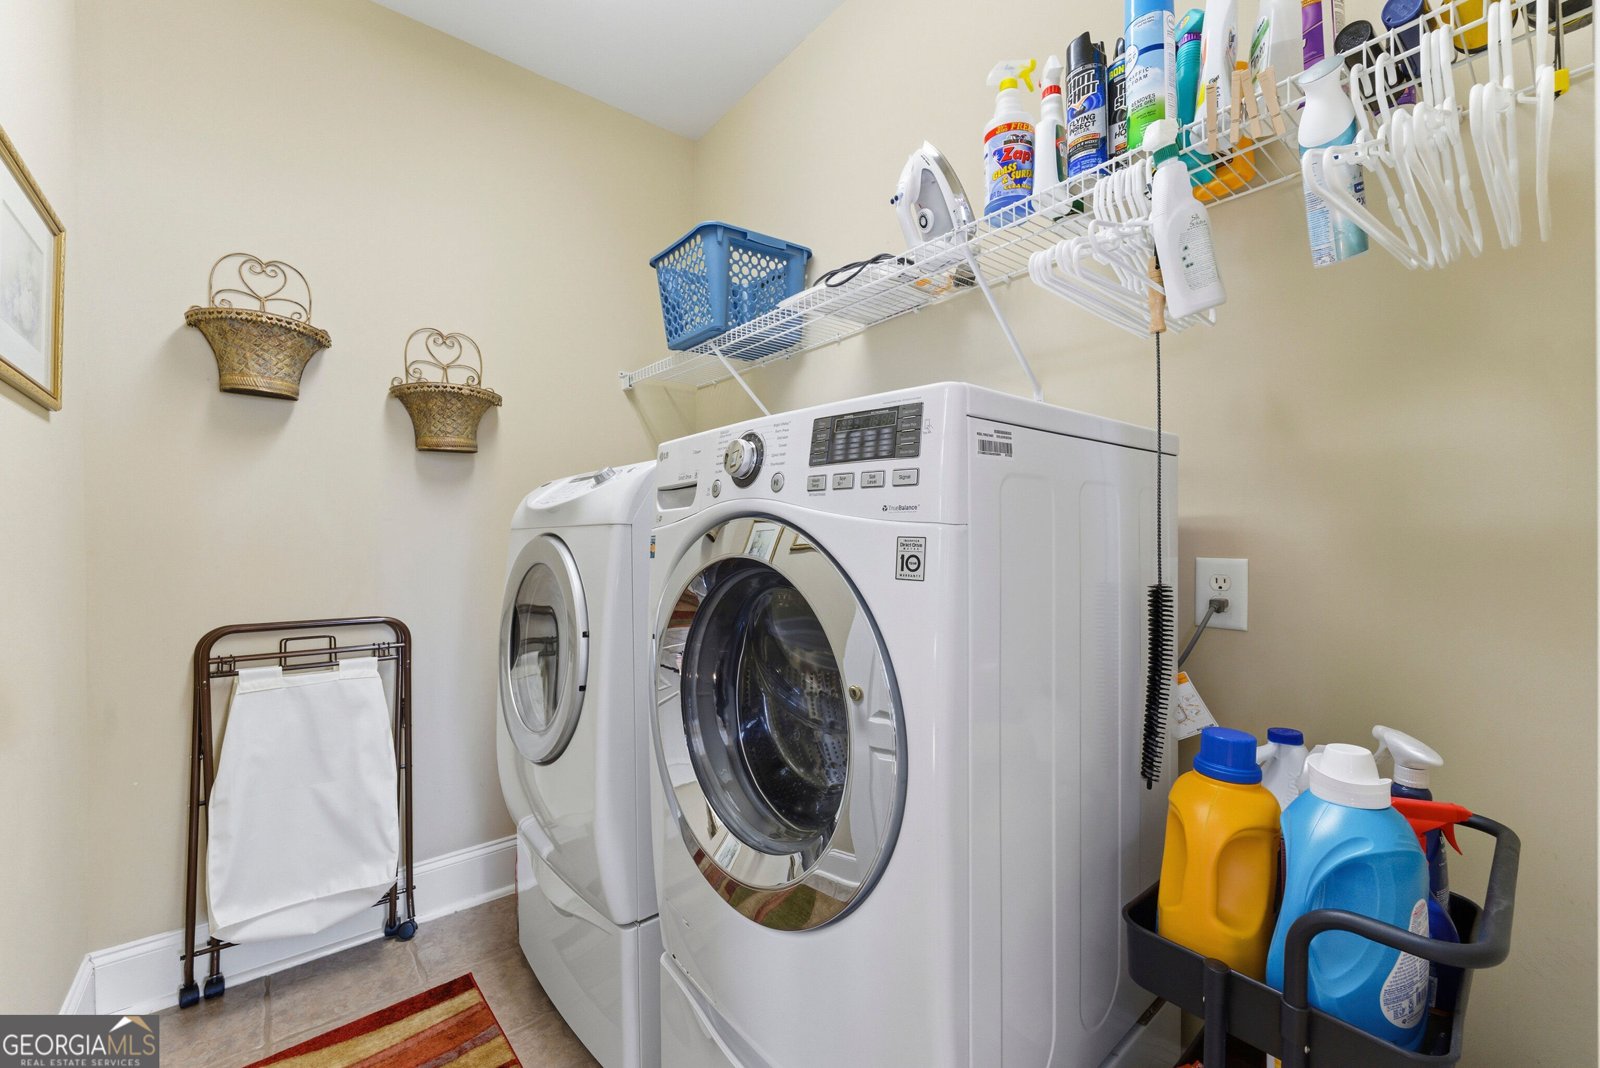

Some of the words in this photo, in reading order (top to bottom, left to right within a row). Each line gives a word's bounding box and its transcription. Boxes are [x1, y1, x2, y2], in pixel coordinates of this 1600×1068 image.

[1109, 64, 1125, 80] BON
[1067, 69, 1095, 94] HOT
[1067, 80, 1099, 110] SHOT
[1069, 113, 1096, 129] FLYING
[1069, 120, 1097, 136] INSECT
[992, 162, 1017, 181] GLASS
[900, 554, 921, 572] 10
